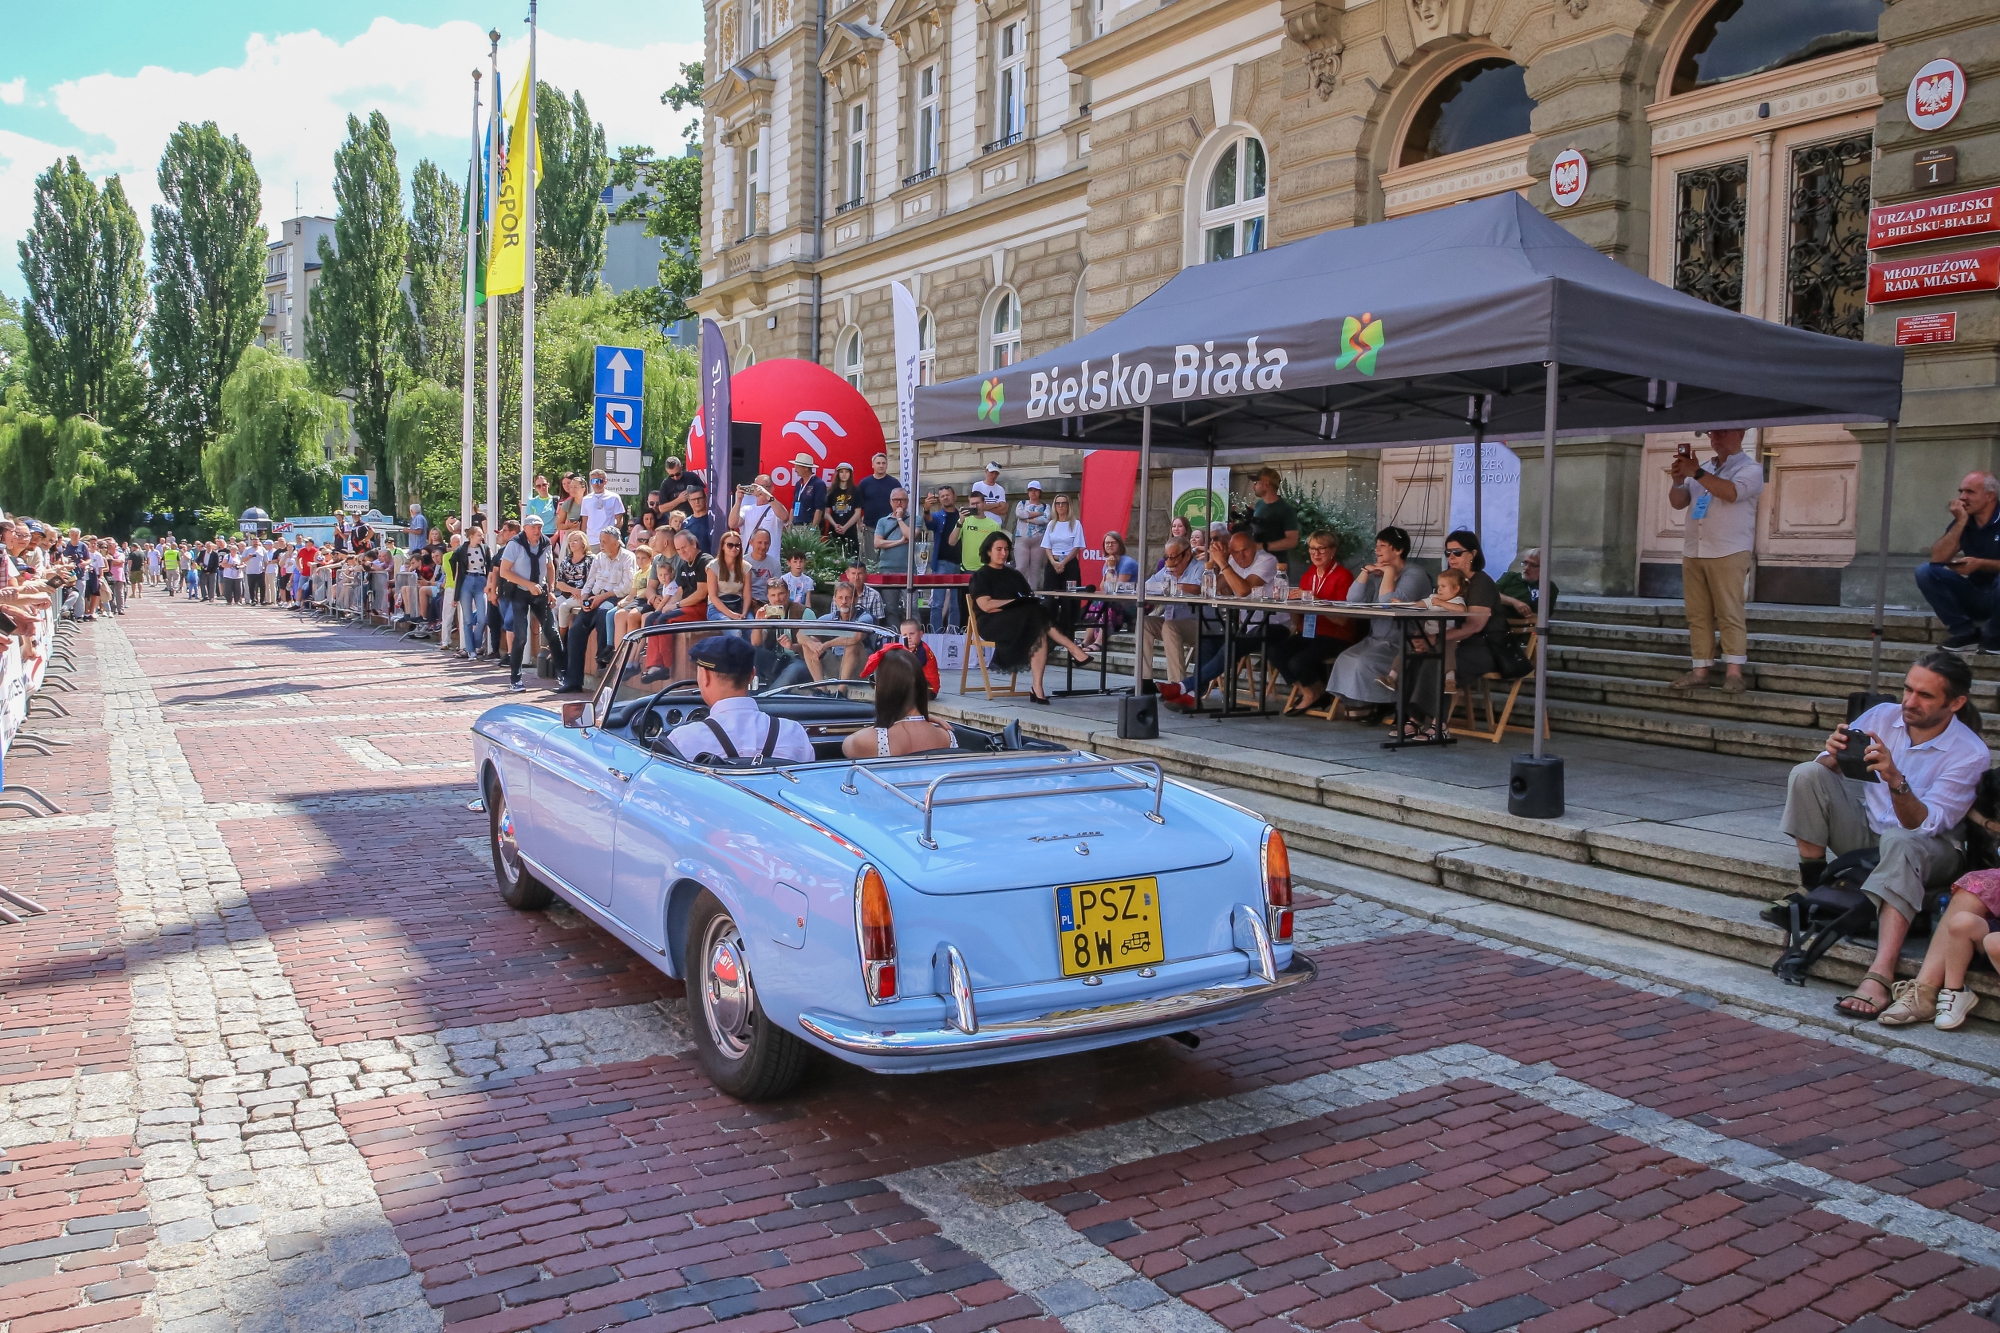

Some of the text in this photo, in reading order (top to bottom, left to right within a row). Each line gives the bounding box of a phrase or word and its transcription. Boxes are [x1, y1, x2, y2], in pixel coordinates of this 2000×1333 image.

[1928, 163, 1939, 183] 1
[1878, 197, 1994, 226] URZĄD MIEJSKI
[1887, 213, 1991, 238] BIELSKU-BIAŁEJ
[1883, 259, 1981, 280] MŁODZIEŻOWA
[1885, 272, 1978, 293] RADA MIASTA
[1026, 335, 1288, 419] Bielsko-Biała
[1460, 446, 1496, 458] POSKI
[1458, 460, 1503, 472] ZWZEK
[1457, 473, 1519, 485] MOOROWY
[344, 502, 368, 510] Koniec
[241, 523, 256, 531] TAXI
[1082, 549, 1109, 560] ORL
[1080, 885, 1138, 925] PSZ
[1062, 915, 1072, 926] PL
[1074, 930, 1112, 969] 8W
